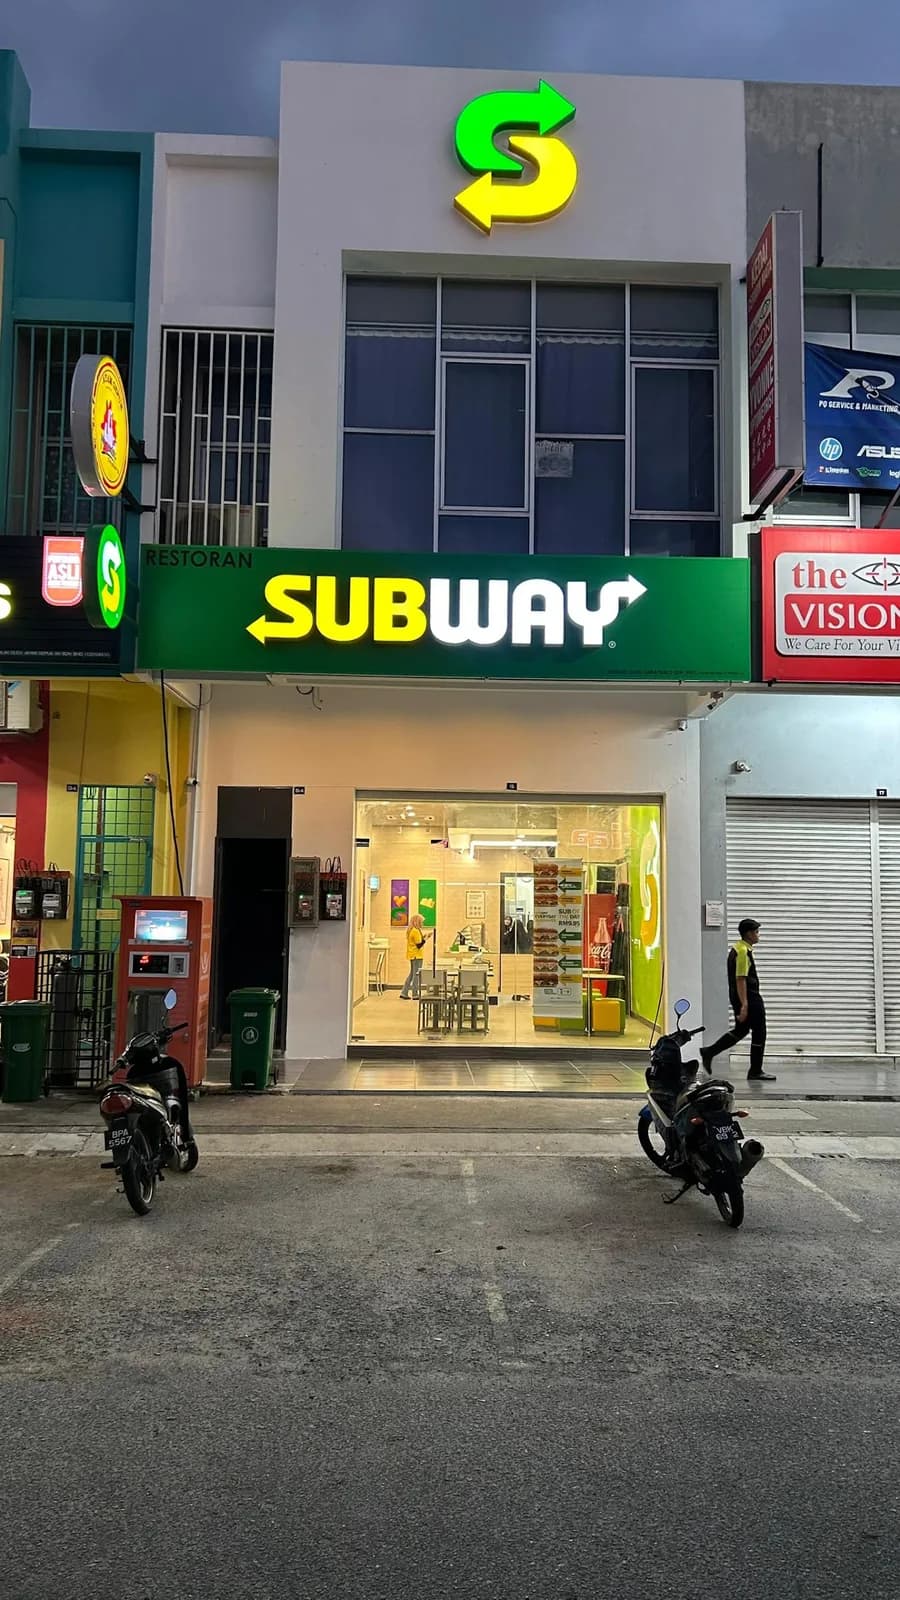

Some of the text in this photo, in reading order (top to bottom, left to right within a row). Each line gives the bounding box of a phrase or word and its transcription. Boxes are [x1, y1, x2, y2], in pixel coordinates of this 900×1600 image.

[828, 400, 855, 410] SERVICE
[862, 402, 899, 413] MARKETING
[820, 438, 842, 460] hp
[145, 549, 253, 569] RESTORAN
[791, 560, 848, 589] the
[246, 574, 648, 646] SUBWAY
[784, 638, 801, 650] We
[804, 638, 831, 650] Care
[834, 638, 854, 651] For
[857, 639, 884, 651] Your
[108, 1135, 132, 1148] 5567
[112, 1128, 129, 1139] BPA
